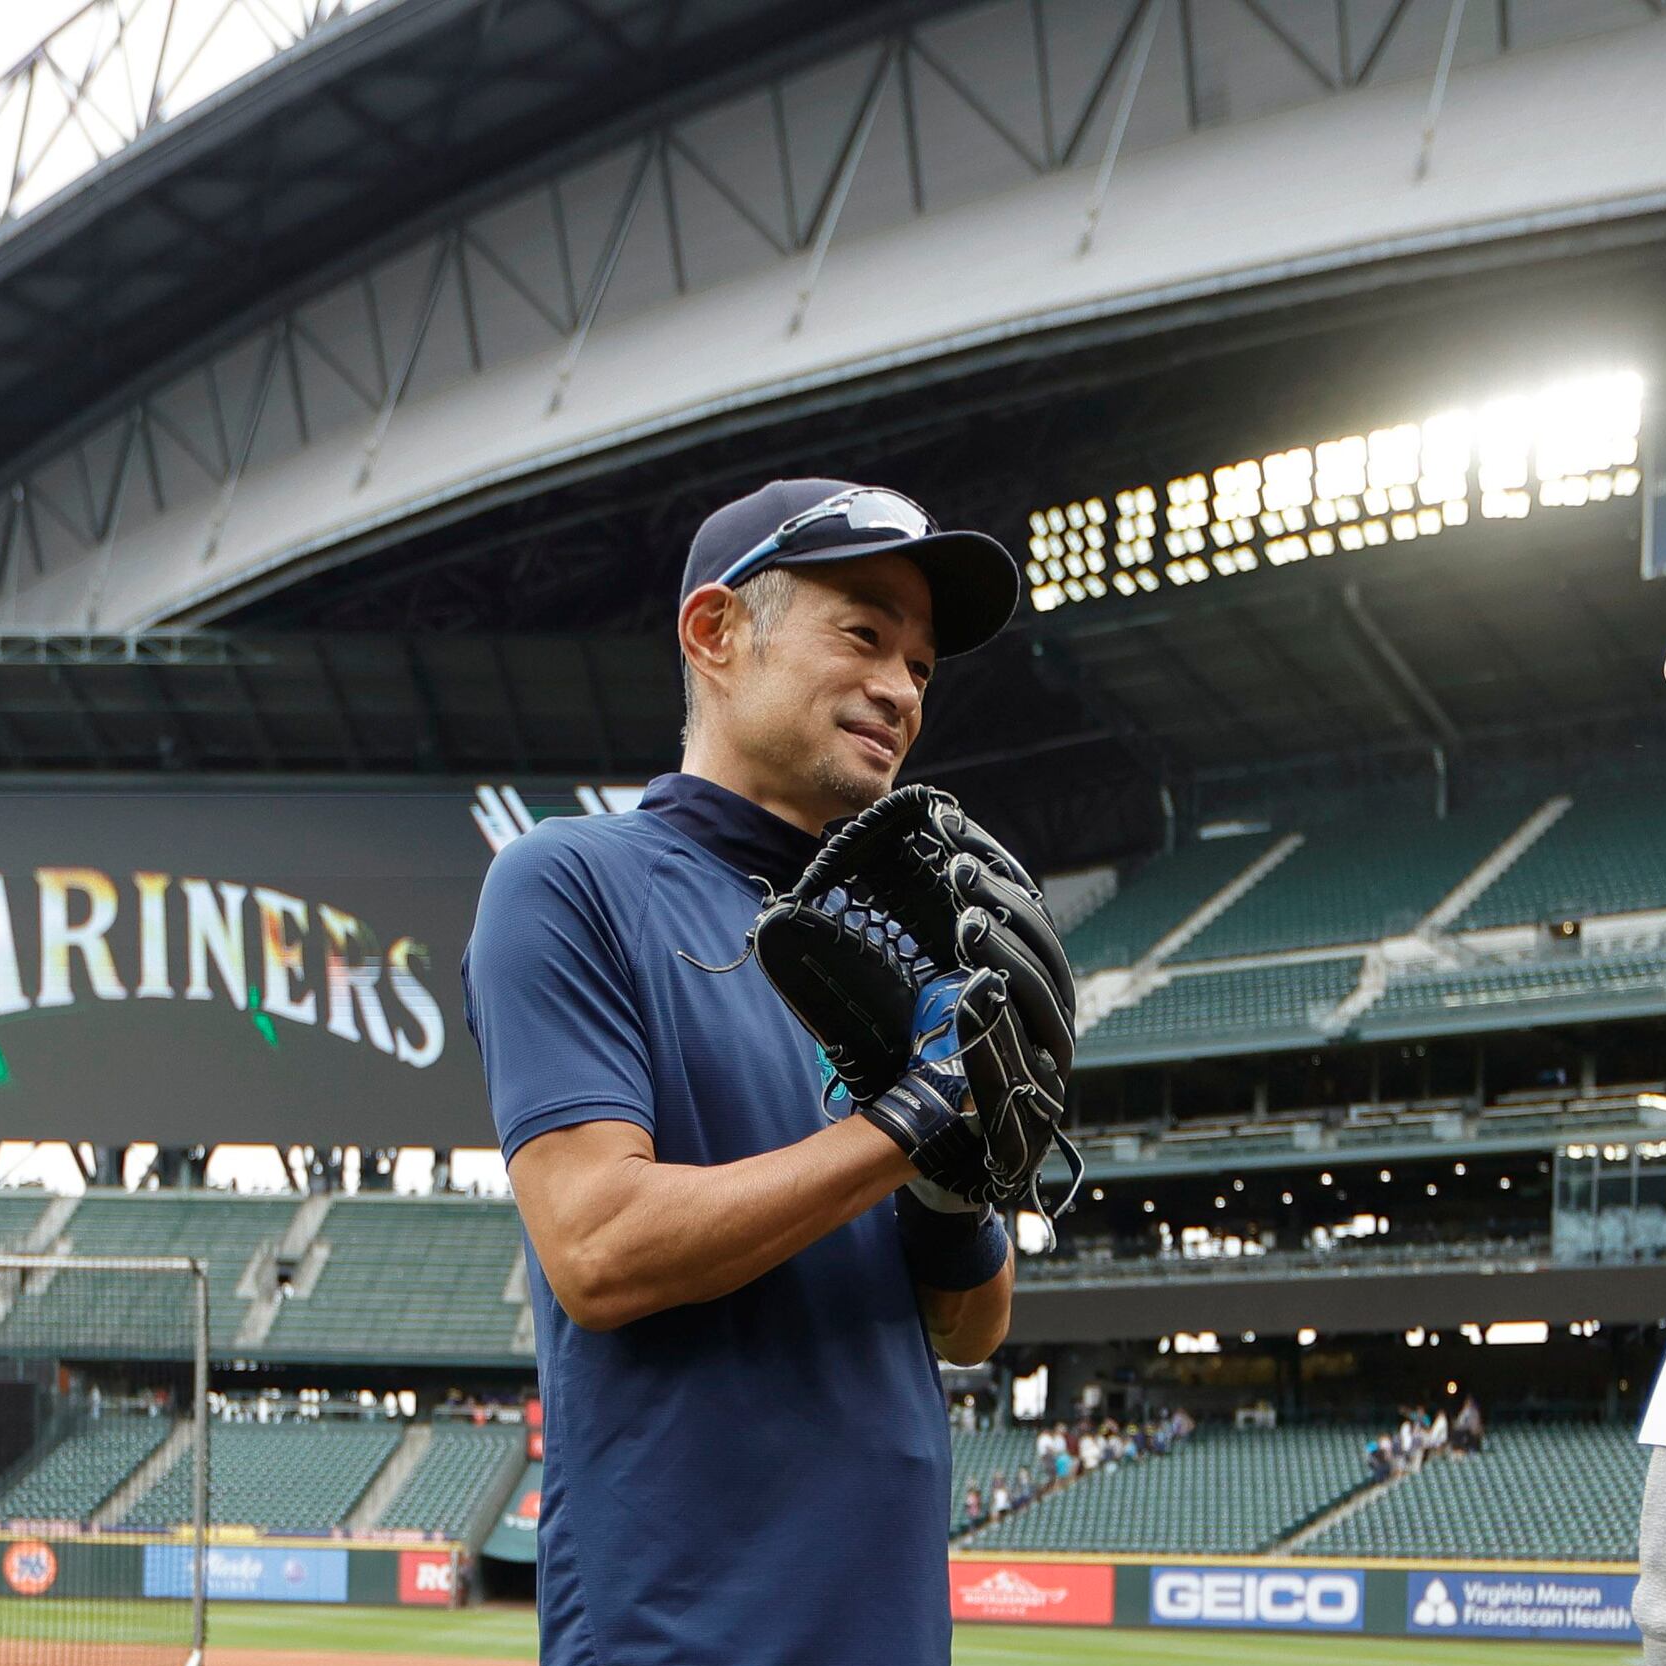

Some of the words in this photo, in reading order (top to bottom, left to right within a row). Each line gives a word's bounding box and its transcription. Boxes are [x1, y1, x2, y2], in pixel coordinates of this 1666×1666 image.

[1153, 1572, 1359, 1624] GEICO
[1463, 1581, 1533, 1607] Virginia
[1536, 1582, 1601, 1607] Mason
[1463, 1603, 1564, 1628] Franciscan
[1566, 1606, 1631, 1630] Health
